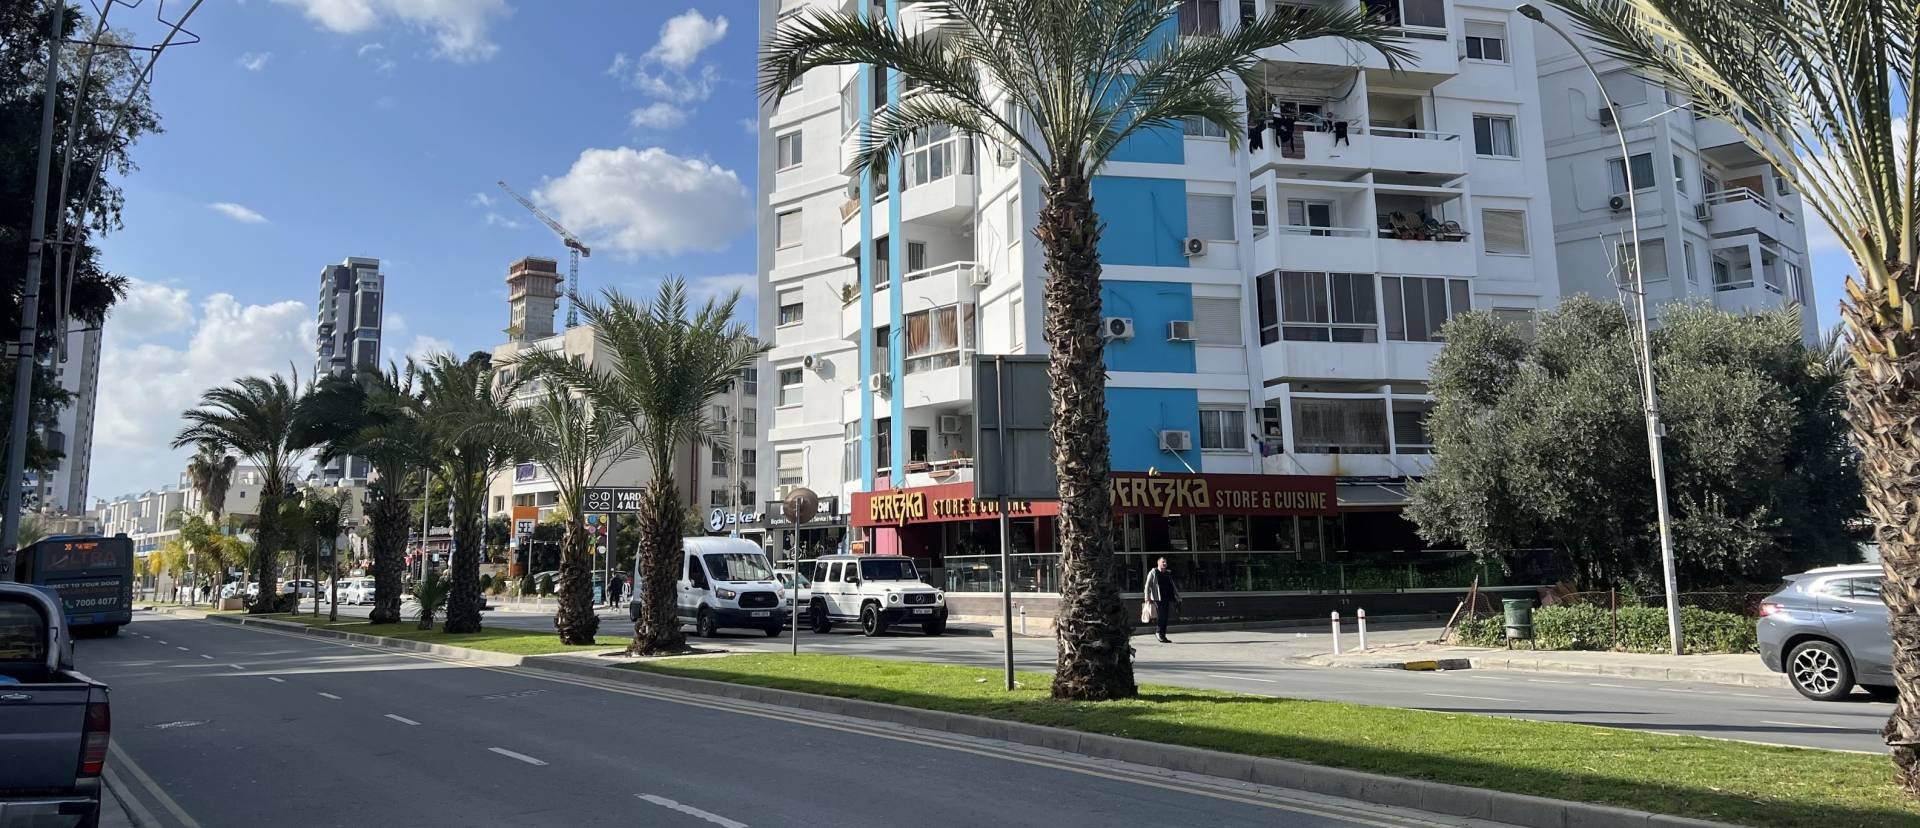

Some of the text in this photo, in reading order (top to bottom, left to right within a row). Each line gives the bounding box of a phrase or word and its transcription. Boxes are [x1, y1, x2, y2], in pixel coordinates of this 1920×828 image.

[617, 492, 641, 501] YARD
[1216, 490, 1259, 508] STORE
[1262, 491, 1271, 508] &
[1274, 491, 1327, 509] CUISINE
[616, 501, 641, 510] 4 ALL
[933, 498, 965, 516] STORE
[970, 497, 976, 513] &
[980, 501, 1027, 512] CUIINE
